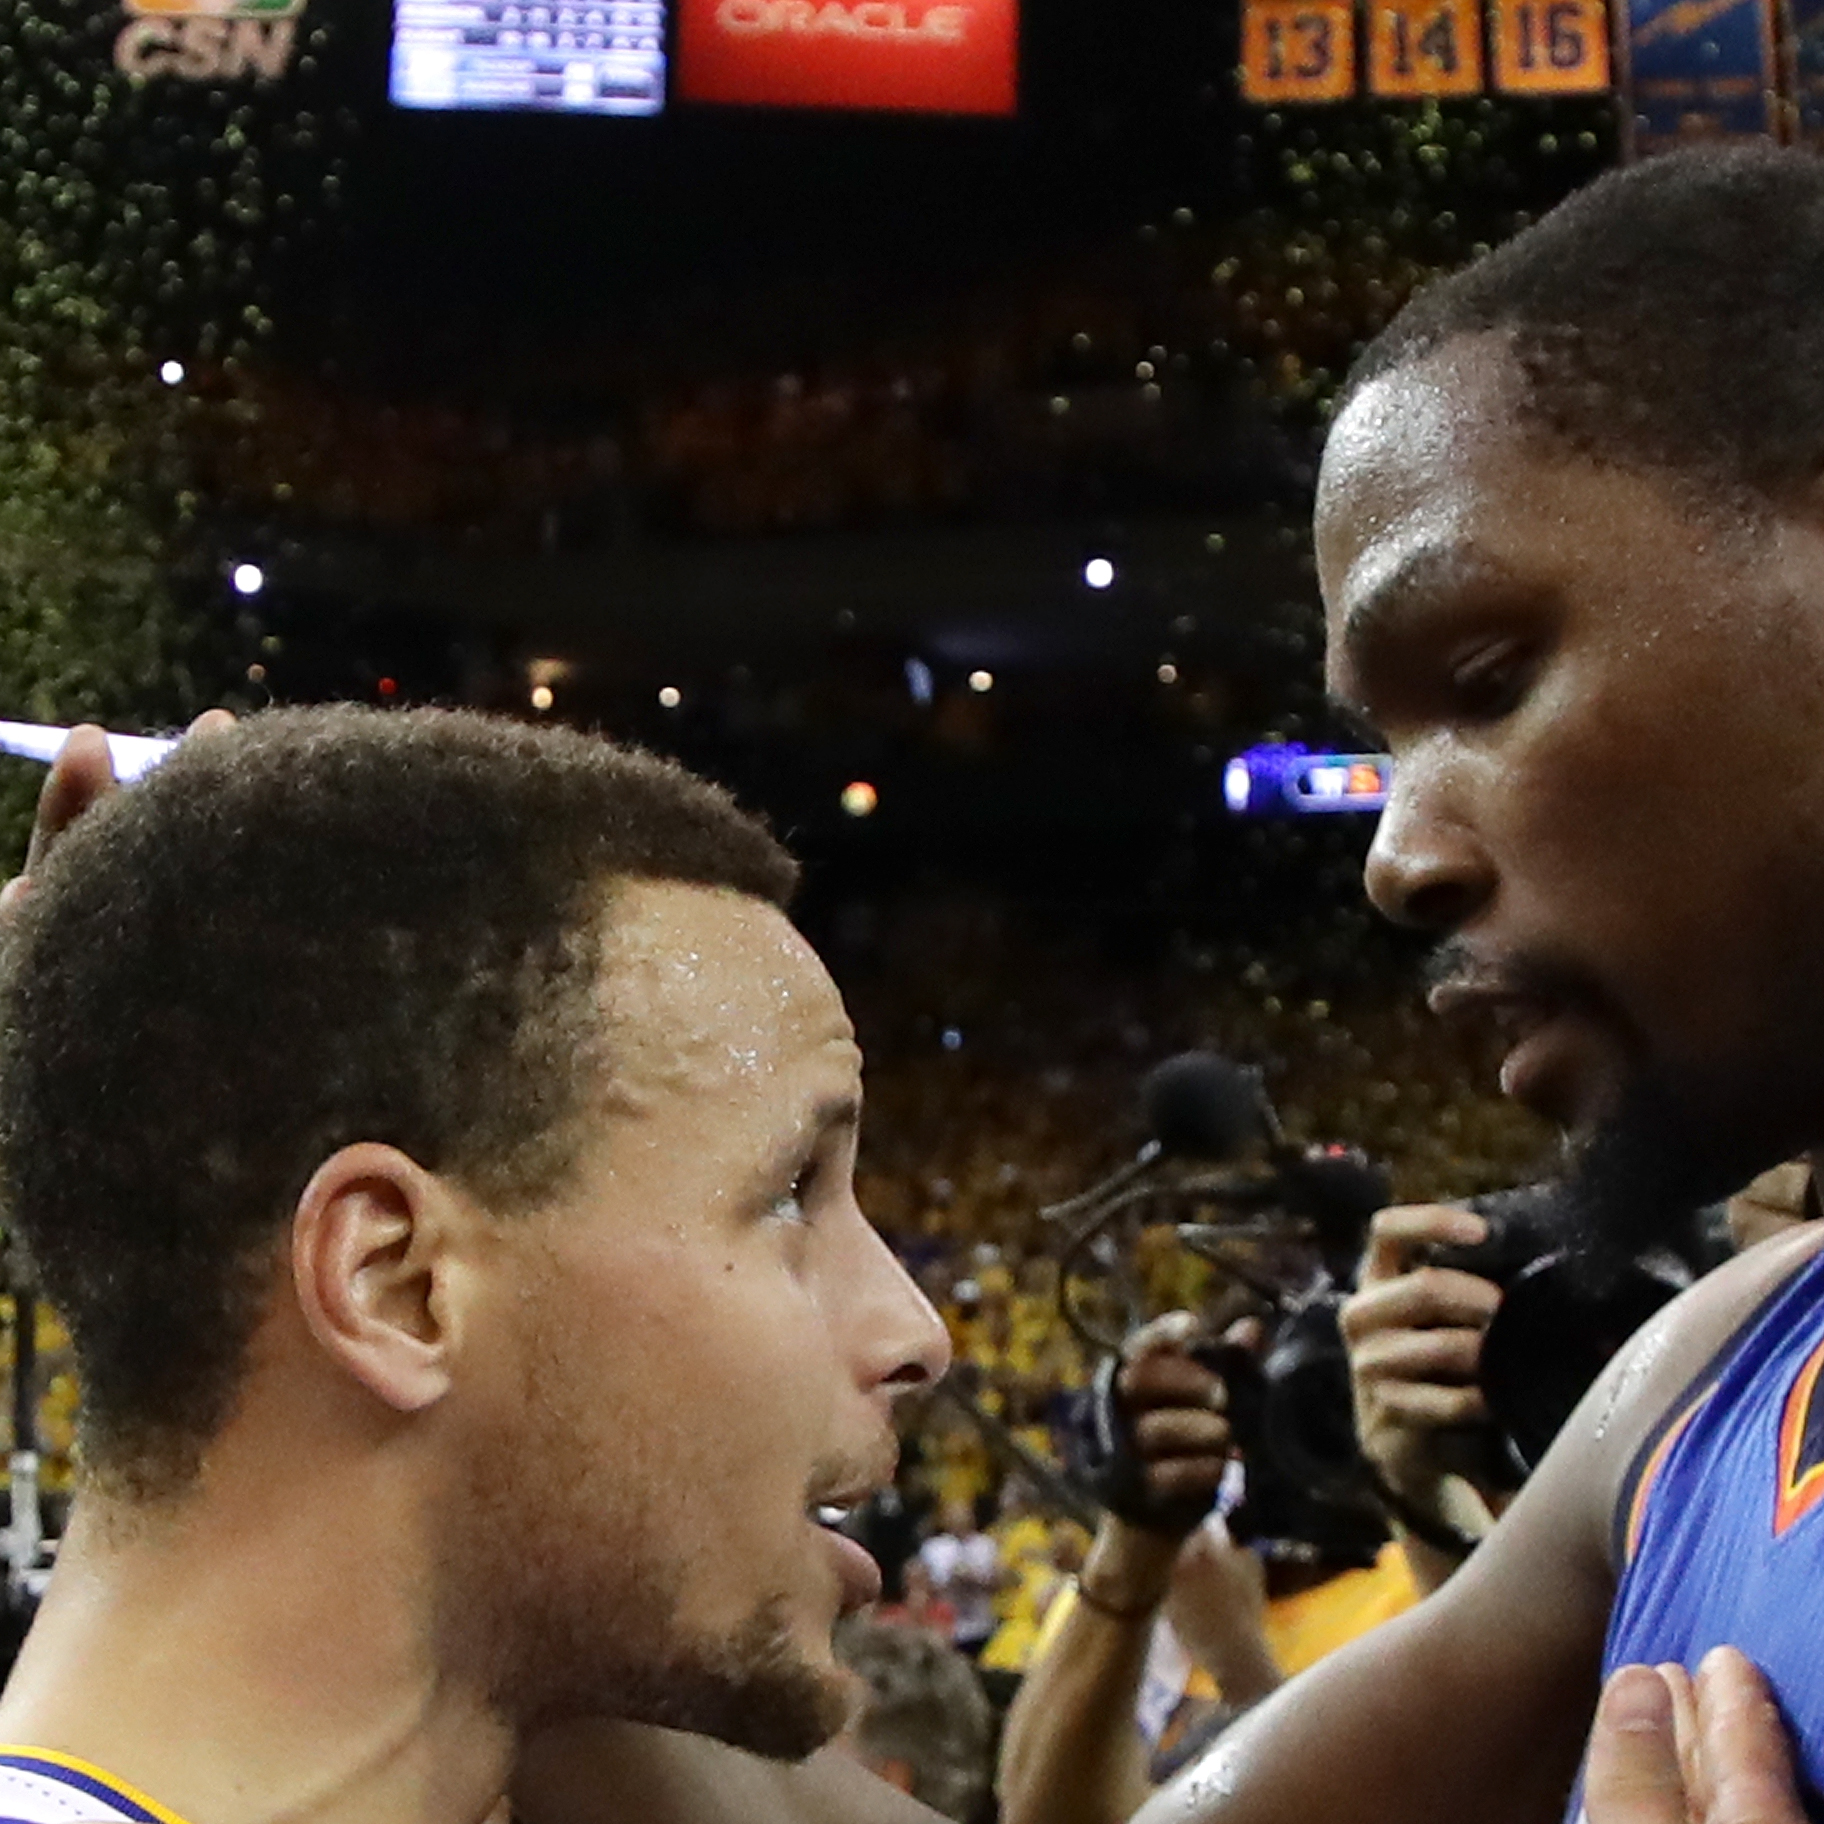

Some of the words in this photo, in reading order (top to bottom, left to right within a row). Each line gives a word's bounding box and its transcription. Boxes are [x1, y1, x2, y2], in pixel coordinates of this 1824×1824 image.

[113, 15, 297, 82] CSN
[714, 0, 969, 46] ORACLE
[1264, 14, 1334, 80] 13
[1393, 10, 1459, 75] 14
[1516, 3, 1584, 70] 16
